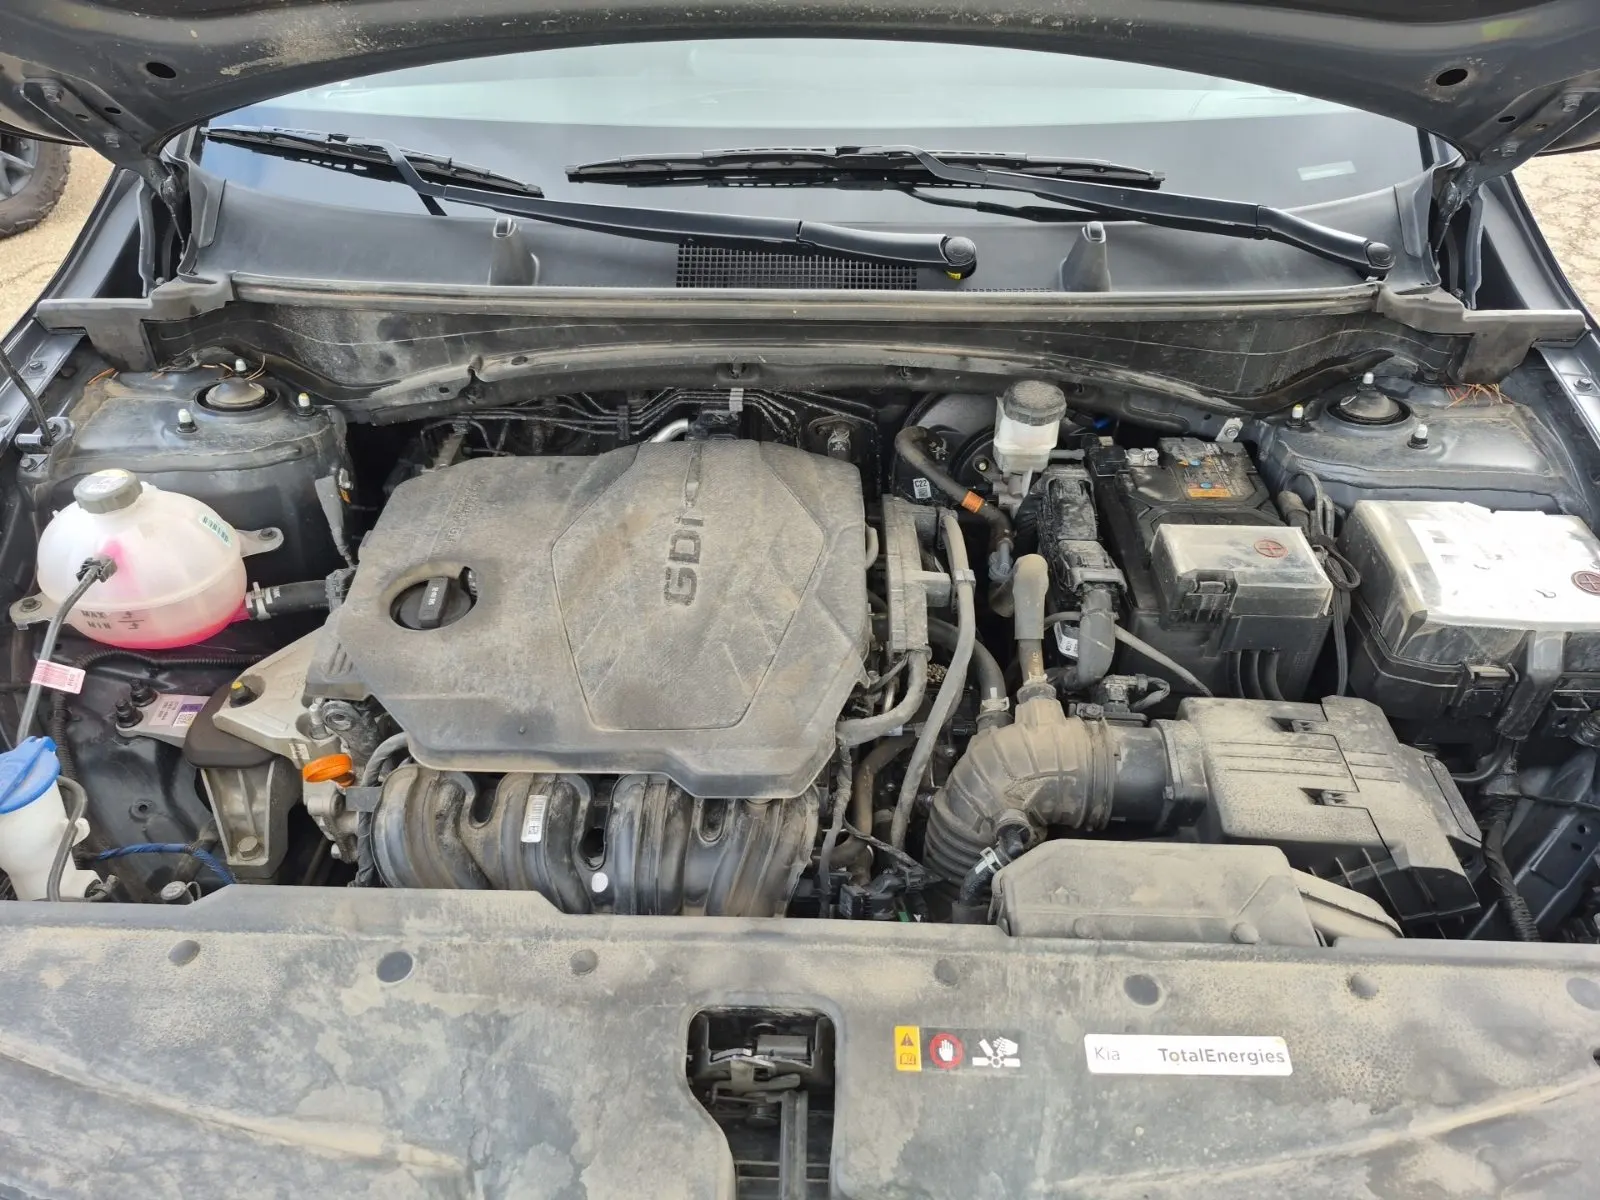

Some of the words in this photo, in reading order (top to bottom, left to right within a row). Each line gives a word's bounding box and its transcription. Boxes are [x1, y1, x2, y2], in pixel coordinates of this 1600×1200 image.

[914, 479, 928, 488] C22
[663, 516, 704, 606] GDi
[80, 610, 106, 619] MAX
[87, 620, 112, 630] MIN
[1094, 1046, 1120, 1061] Kia
[1157, 1047, 1285, 1066] TotalEnergies
